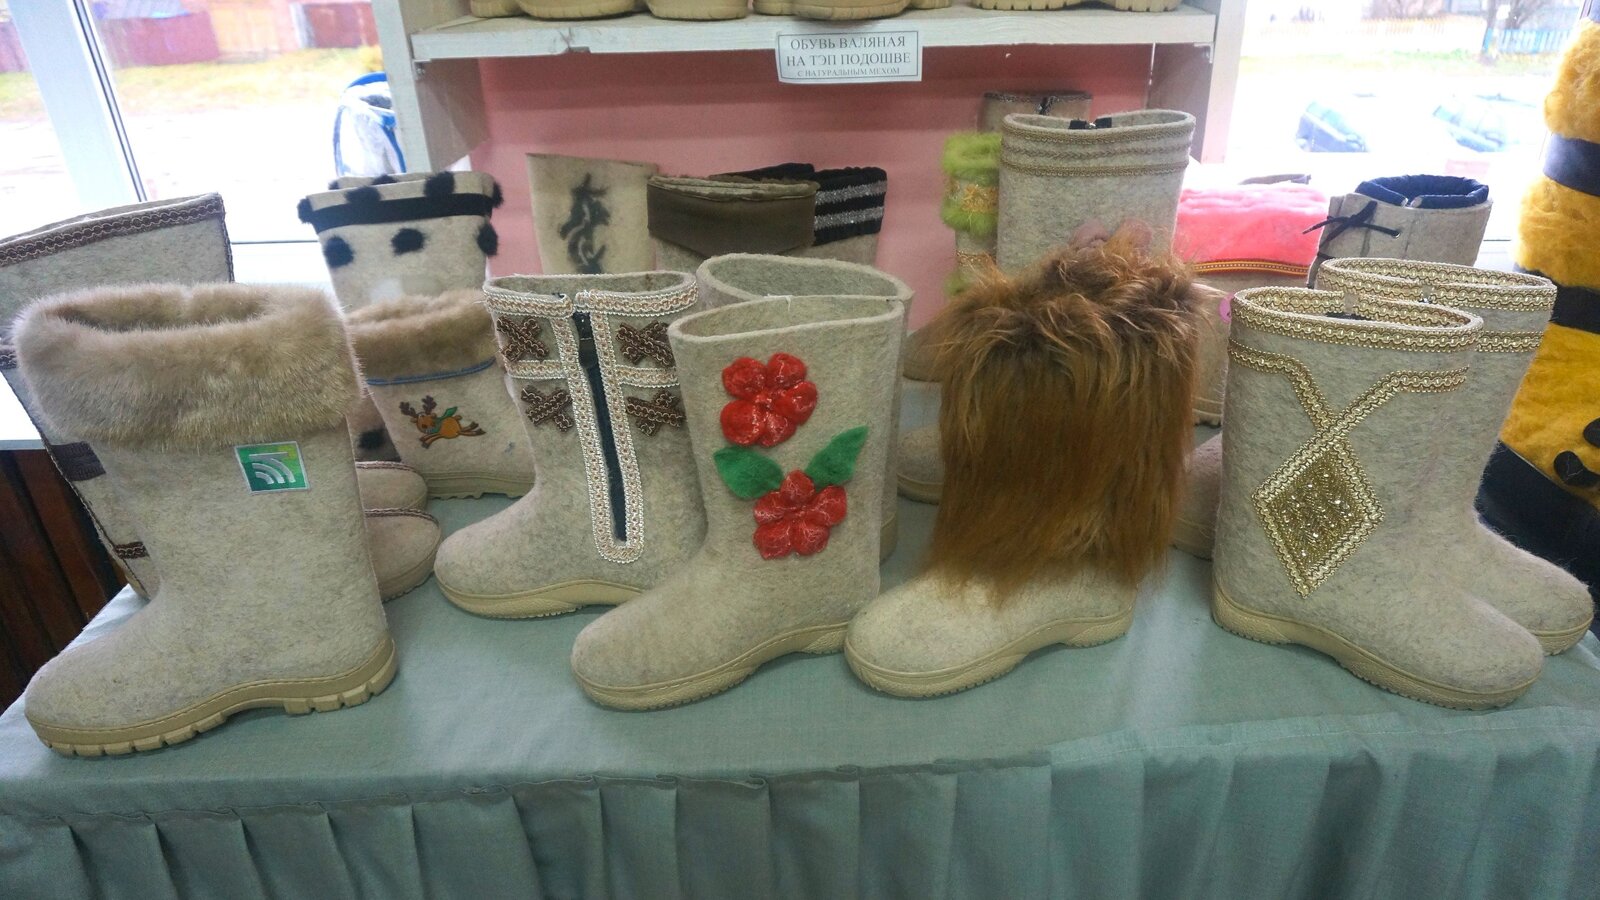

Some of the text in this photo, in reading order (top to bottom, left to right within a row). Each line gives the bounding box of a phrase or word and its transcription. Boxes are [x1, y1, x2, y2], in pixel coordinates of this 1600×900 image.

[790, 36, 906, 50] ОБУВЬ ВАЛЯНАЯ
[786, 52, 912, 67] НА ТЭП ПОДОШВЕ
[805, 69, 867, 77] НАТУРАЛЬНЫМ
[868, 67, 900, 75] МЕХОМ
